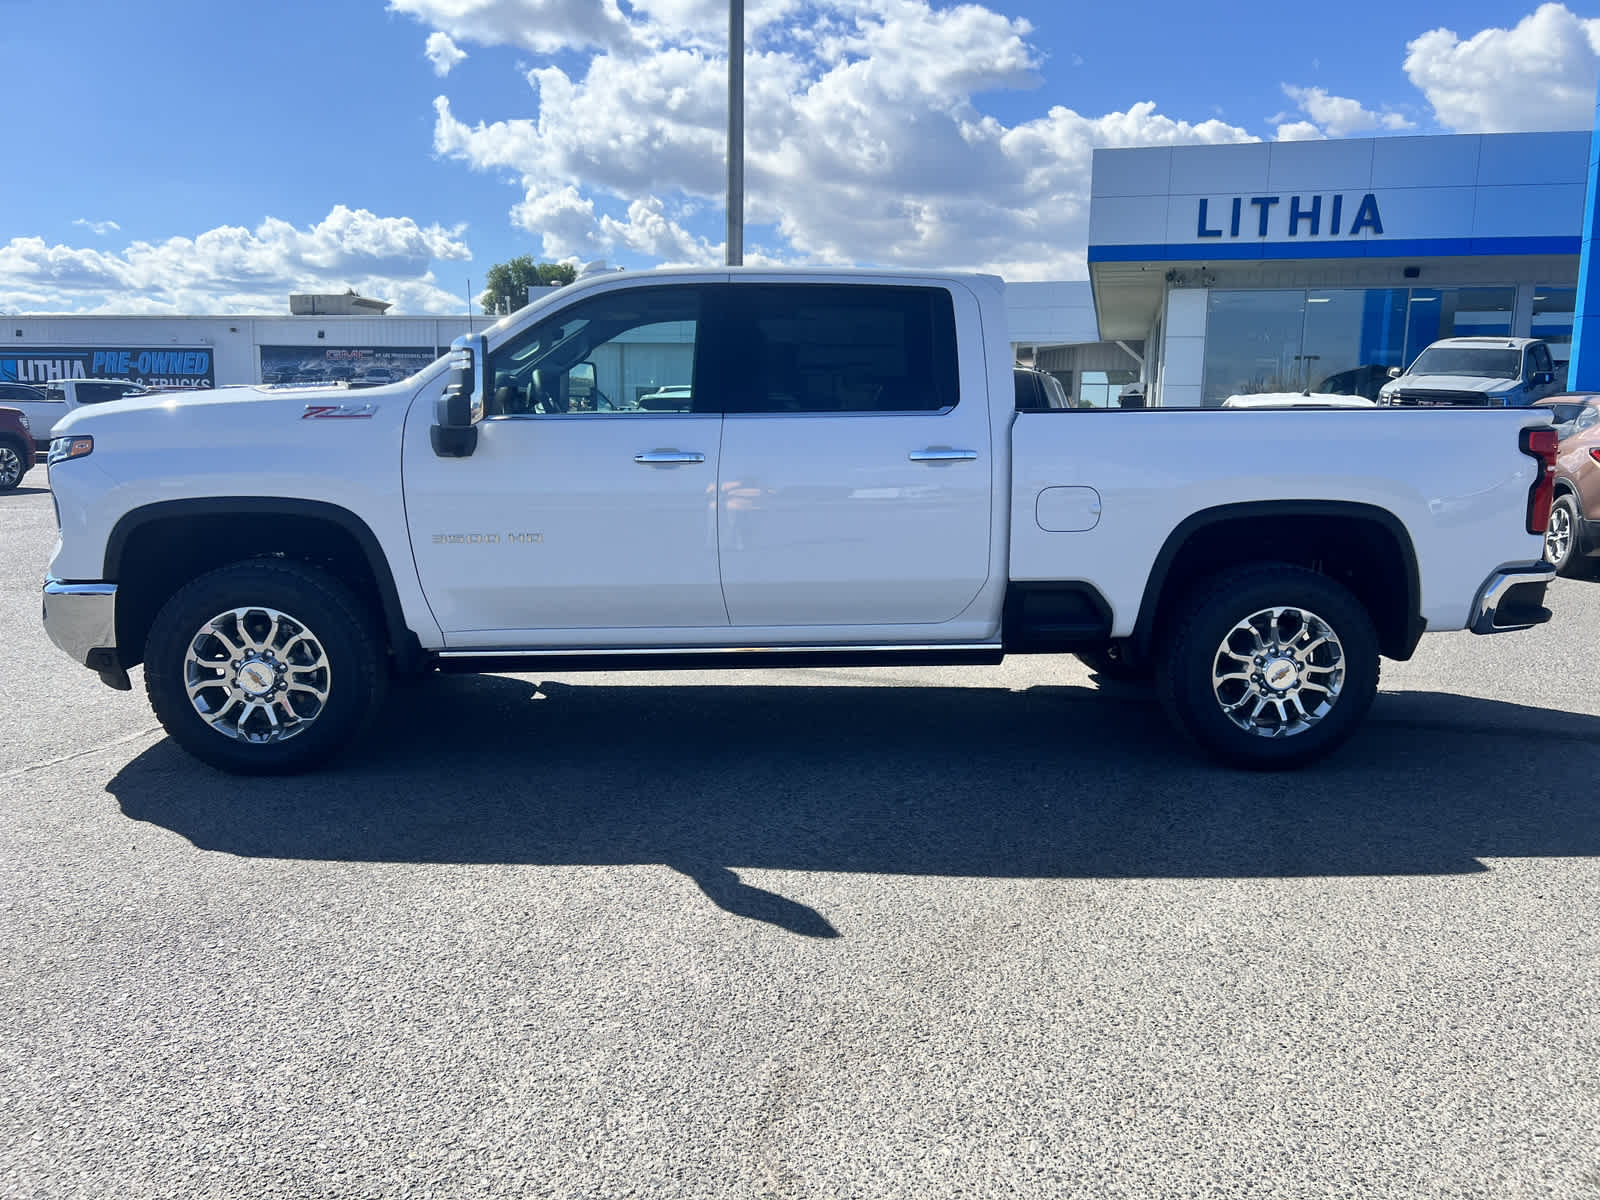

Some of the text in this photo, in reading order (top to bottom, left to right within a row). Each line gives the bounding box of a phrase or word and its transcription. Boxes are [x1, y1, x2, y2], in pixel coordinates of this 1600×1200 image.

[1197, 193, 1383, 237] LITHIA
[92, 351, 209, 375] PRE-OWNED
[326, 350, 374, 360] GMC
[17, 359, 87, 381] LITHIA
[507, 533, 543, 544] HD
